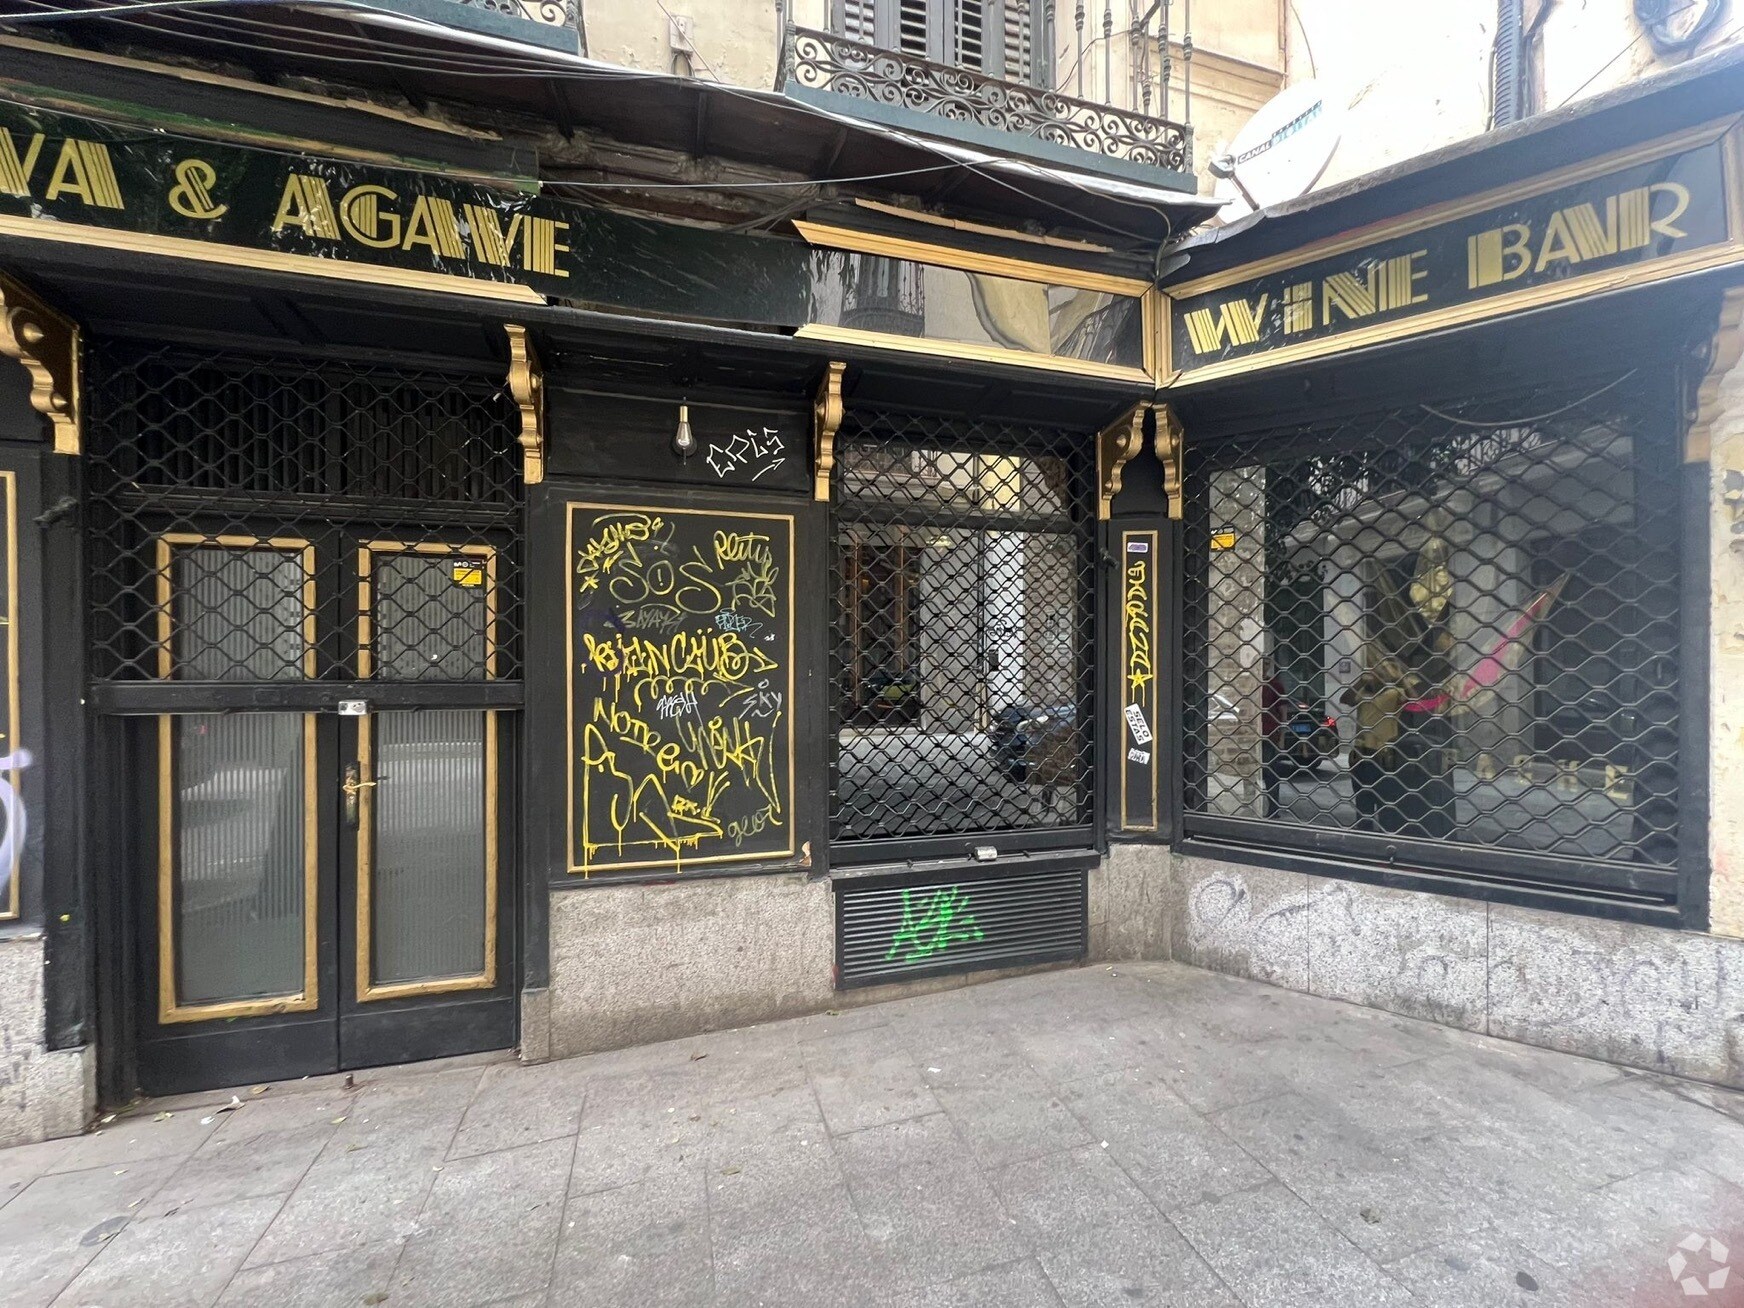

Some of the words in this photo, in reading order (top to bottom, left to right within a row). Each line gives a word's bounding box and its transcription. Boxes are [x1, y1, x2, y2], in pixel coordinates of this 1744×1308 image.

[168, 158, 229, 219] &
[271, 173, 570, 278] AGAVE
[1468, 182, 1689, 290] BAR
